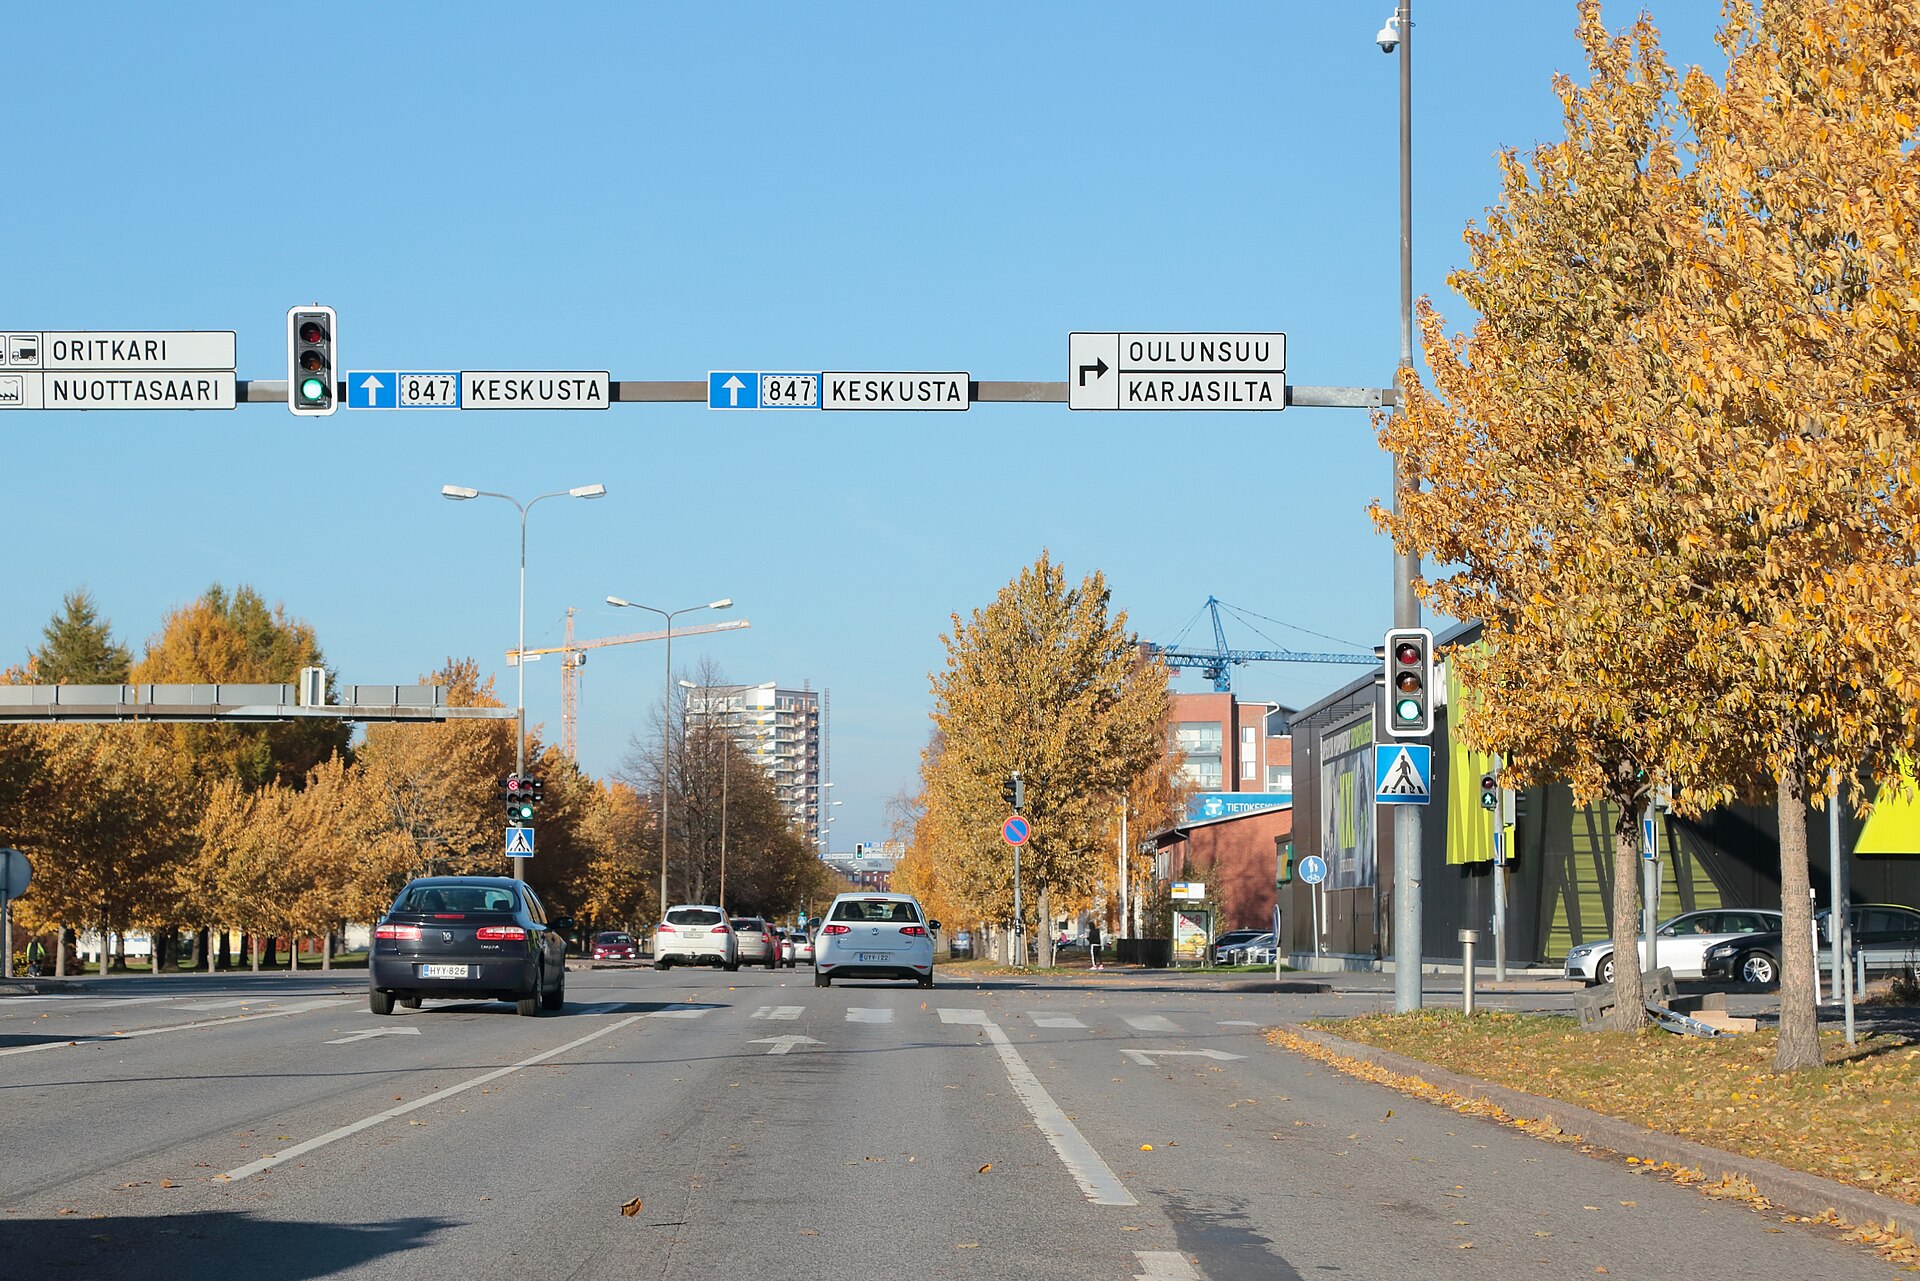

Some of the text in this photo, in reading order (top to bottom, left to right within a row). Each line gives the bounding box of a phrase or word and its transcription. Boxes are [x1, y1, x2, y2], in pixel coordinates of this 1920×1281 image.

[53, 340, 167, 361] ORITKARI
[1129, 341, 1270, 362] OULUNSUU
[53, 380, 219, 401] NUOTTASAARI
[408, 380, 450, 401] 847
[472, 379, 602, 401] KESKUSTA
[769, 380, 811, 401] 847
[832, 380, 961, 402] KESKUSTA
[1129, 381, 1273, 402] KARJASILTA
[1226, 802, 1280, 812] TIETOKES
[429, 966, 466, 975] HYY-826
